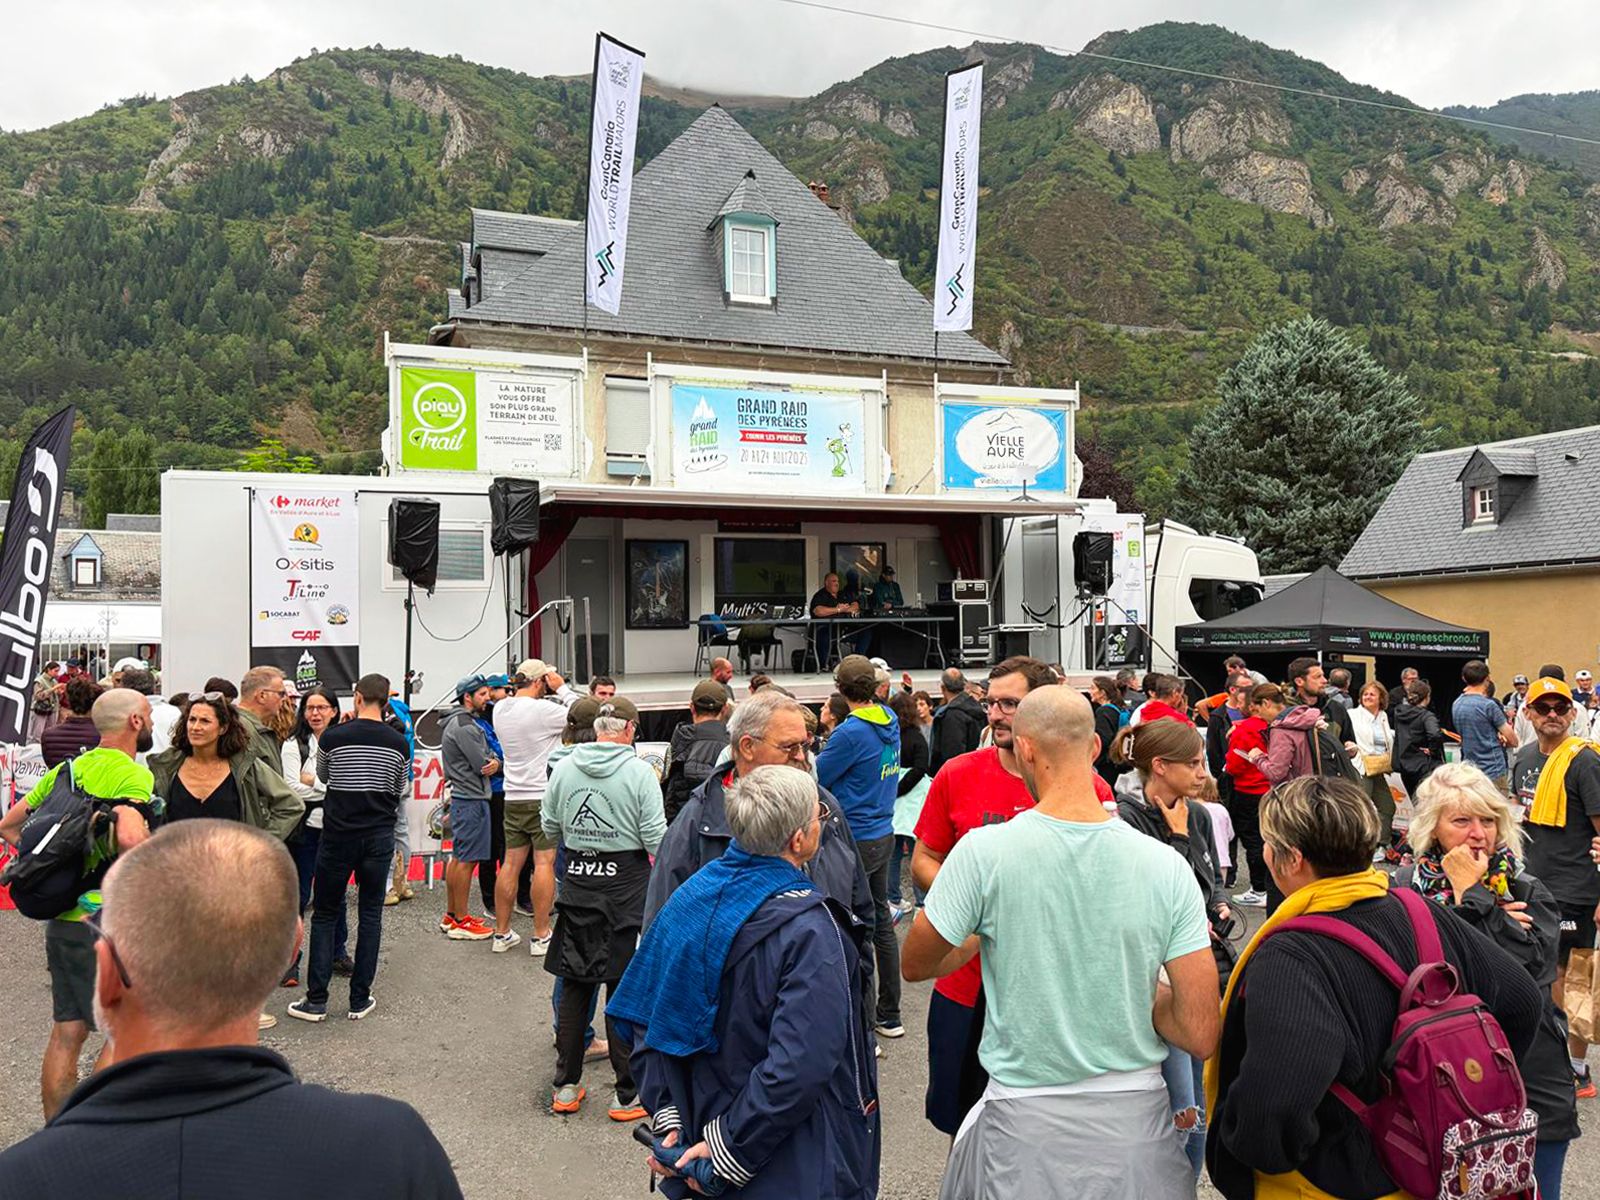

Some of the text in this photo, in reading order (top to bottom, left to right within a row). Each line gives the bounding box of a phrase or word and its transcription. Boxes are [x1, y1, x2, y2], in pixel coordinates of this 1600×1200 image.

[601, 120, 616, 201] GranCanaria
[951, 151, 960, 230] GranCanaria
[499, 384, 547, 395] LA NATURE
[420, 397, 460, 414] piau
[497, 393, 546, 404] VOUS OFFRE
[489, 402, 557, 413] SON PLUS GRAND
[736, 397, 808, 416] GRAND RAID
[489, 411, 526, 420] TERRAIN
[538, 414, 558, 422] JEU.
[737, 413, 808, 429] DES PYRÉNÉES
[689, 417, 719, 437] grand
[409, 427, 467, 451] Trail
[690, 430, 718, 447] RAID
[986, 432, 1025, 447] VIELLE
[740, 448, 749, 463] 20
[987, 446, 1025, 461] AURE
[294, 496, 341, 509] market
[275, 557, 335, 571] Oxsitis
[270, 610, 300, 618] SOCABAT
[291, 630, 322, 642] CAF
[1210, 632, 1227, 640] VOTRE
[1369, 630, 1480, 644] www.pyreneeschrono.fr
[14, 760, 47, 777] ValVita
[567, 861, 618, 876] STAFF
